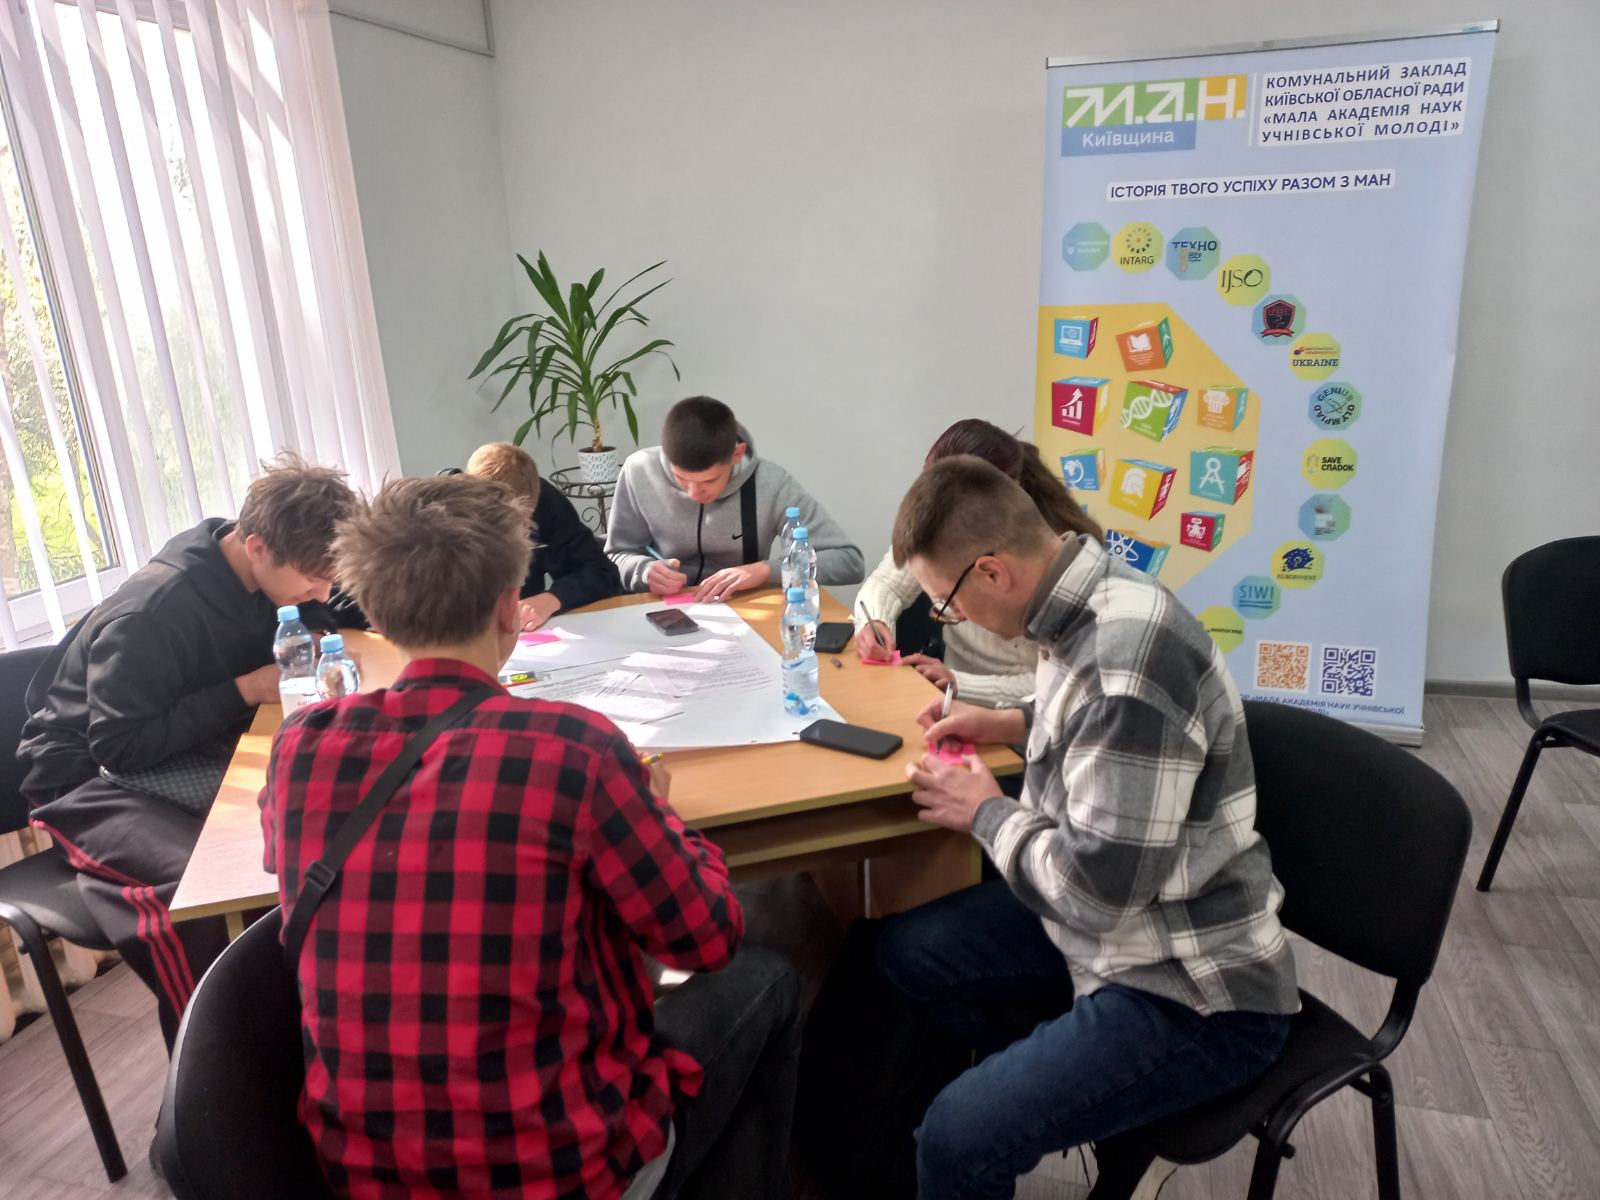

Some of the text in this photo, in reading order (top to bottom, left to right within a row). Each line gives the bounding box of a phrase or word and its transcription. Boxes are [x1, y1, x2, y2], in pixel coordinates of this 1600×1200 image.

[1266, 62, 1467, 89] КОМУНАЛЬНИЙ ЗАКЛАД
[1265, 81, 1464, 107] КИЇВСЬКОЇ ОБЛАСНОЇ РАДИ
[1263, 100, 1463, 124] «МАЛА АКАДЕМІЯ НАУК
[1082, 130, 1175, 148] Київщина
[1262, 120, 1459, 142] УЧНІВСЬКОЇ МОЛОДІ»
[1110, 173, 1391, 198] ІСТОРІЯ ТВОГО УСПІХУ РАЗОМ З МАН
[1120, 255, 1155, 265] INTARG
[1221, 268, 1264, 294] IJSO
[1292, 358, 1340, 367] UKRAINE
[1317, 387, 1354, 402] GENIUS
[1313, 404, 1356, 426] OLYMPIAD
[1321, 456, 1343, 464] SAVE
[1239, 584, 1275, 599] SIWI
[1282, 697, 1327, 708] АКАДЕМІЯ
[1327, 701, 1351, 711] НАУК
[1352, 703, 1405, 715] УЧНІВСЬКОЇ
